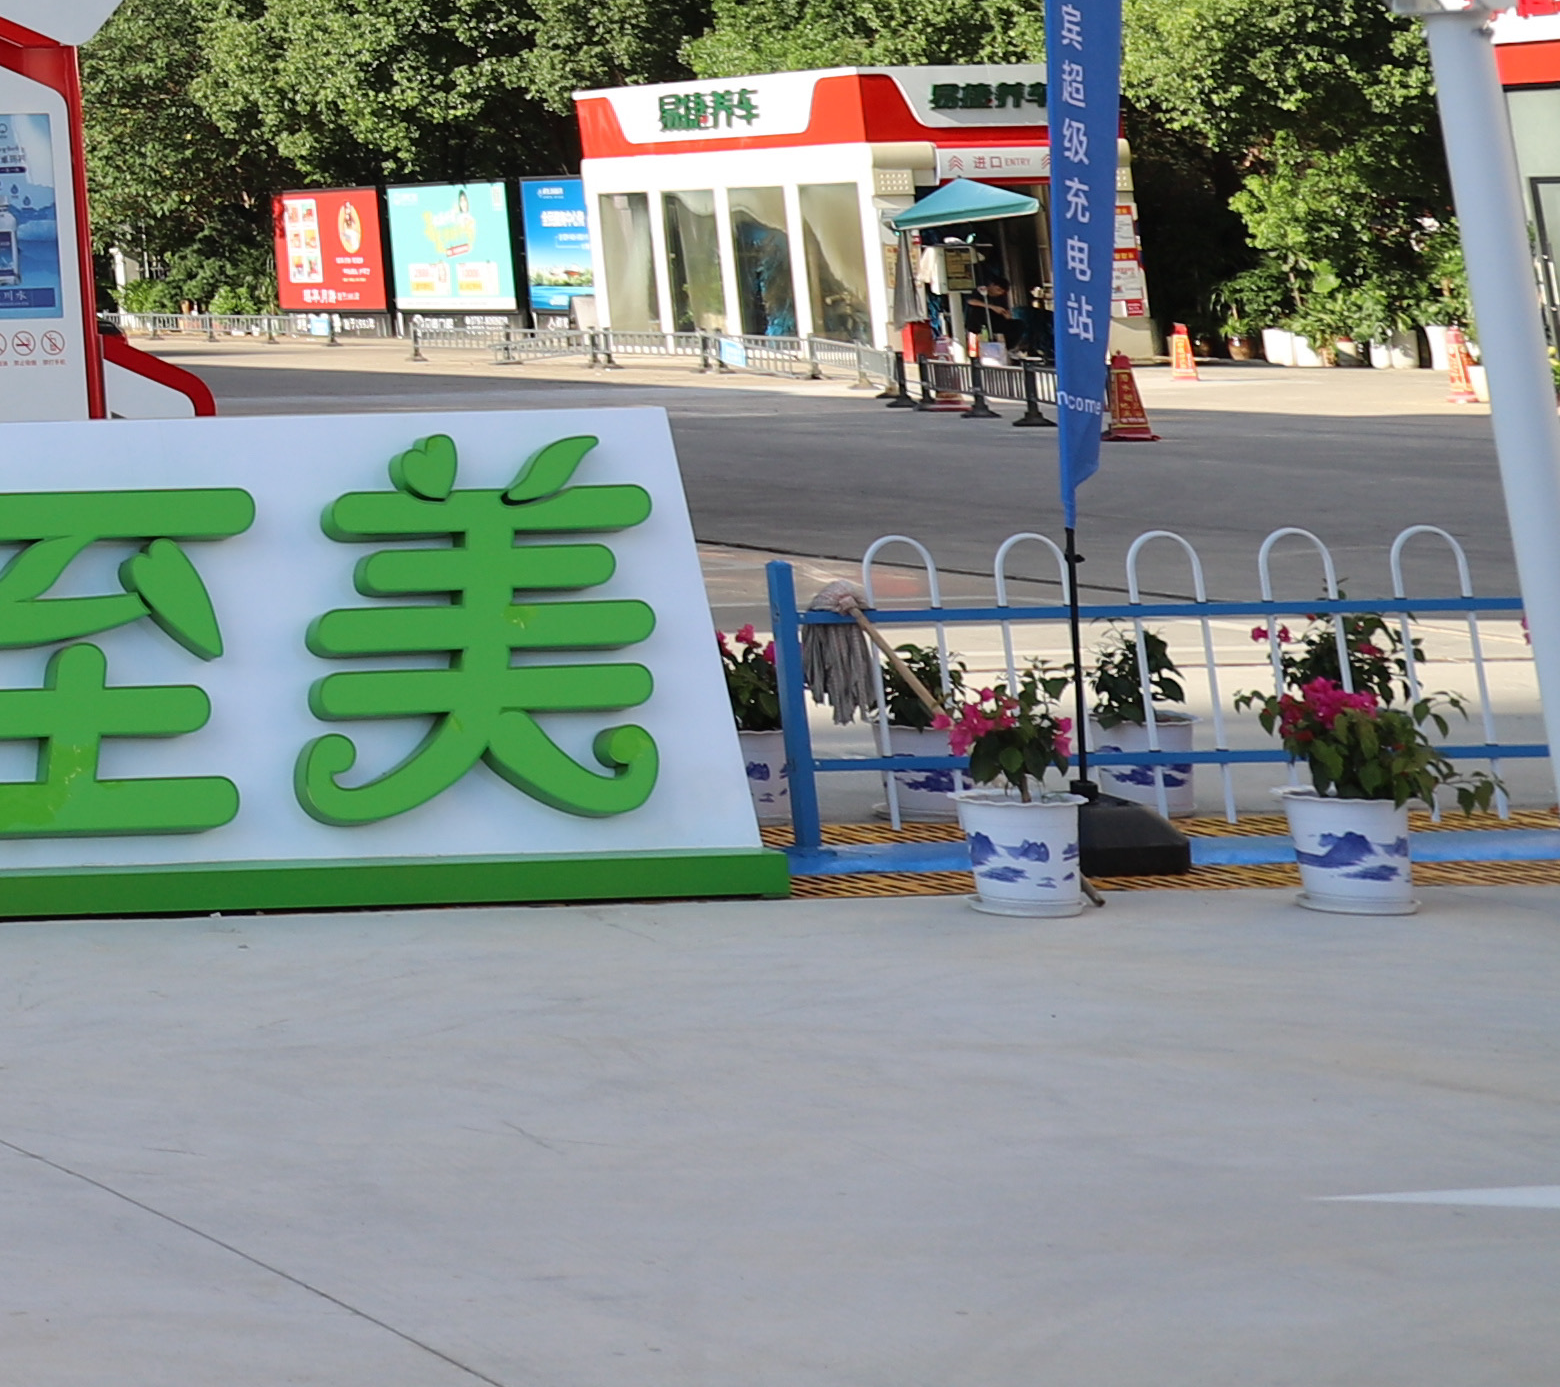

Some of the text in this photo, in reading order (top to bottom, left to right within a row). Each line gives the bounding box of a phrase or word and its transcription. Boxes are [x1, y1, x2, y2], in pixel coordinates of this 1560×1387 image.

[657, 87, 760, 132] 易捷养车
[973, 155, 1031, 170] 进口 ENTRY
